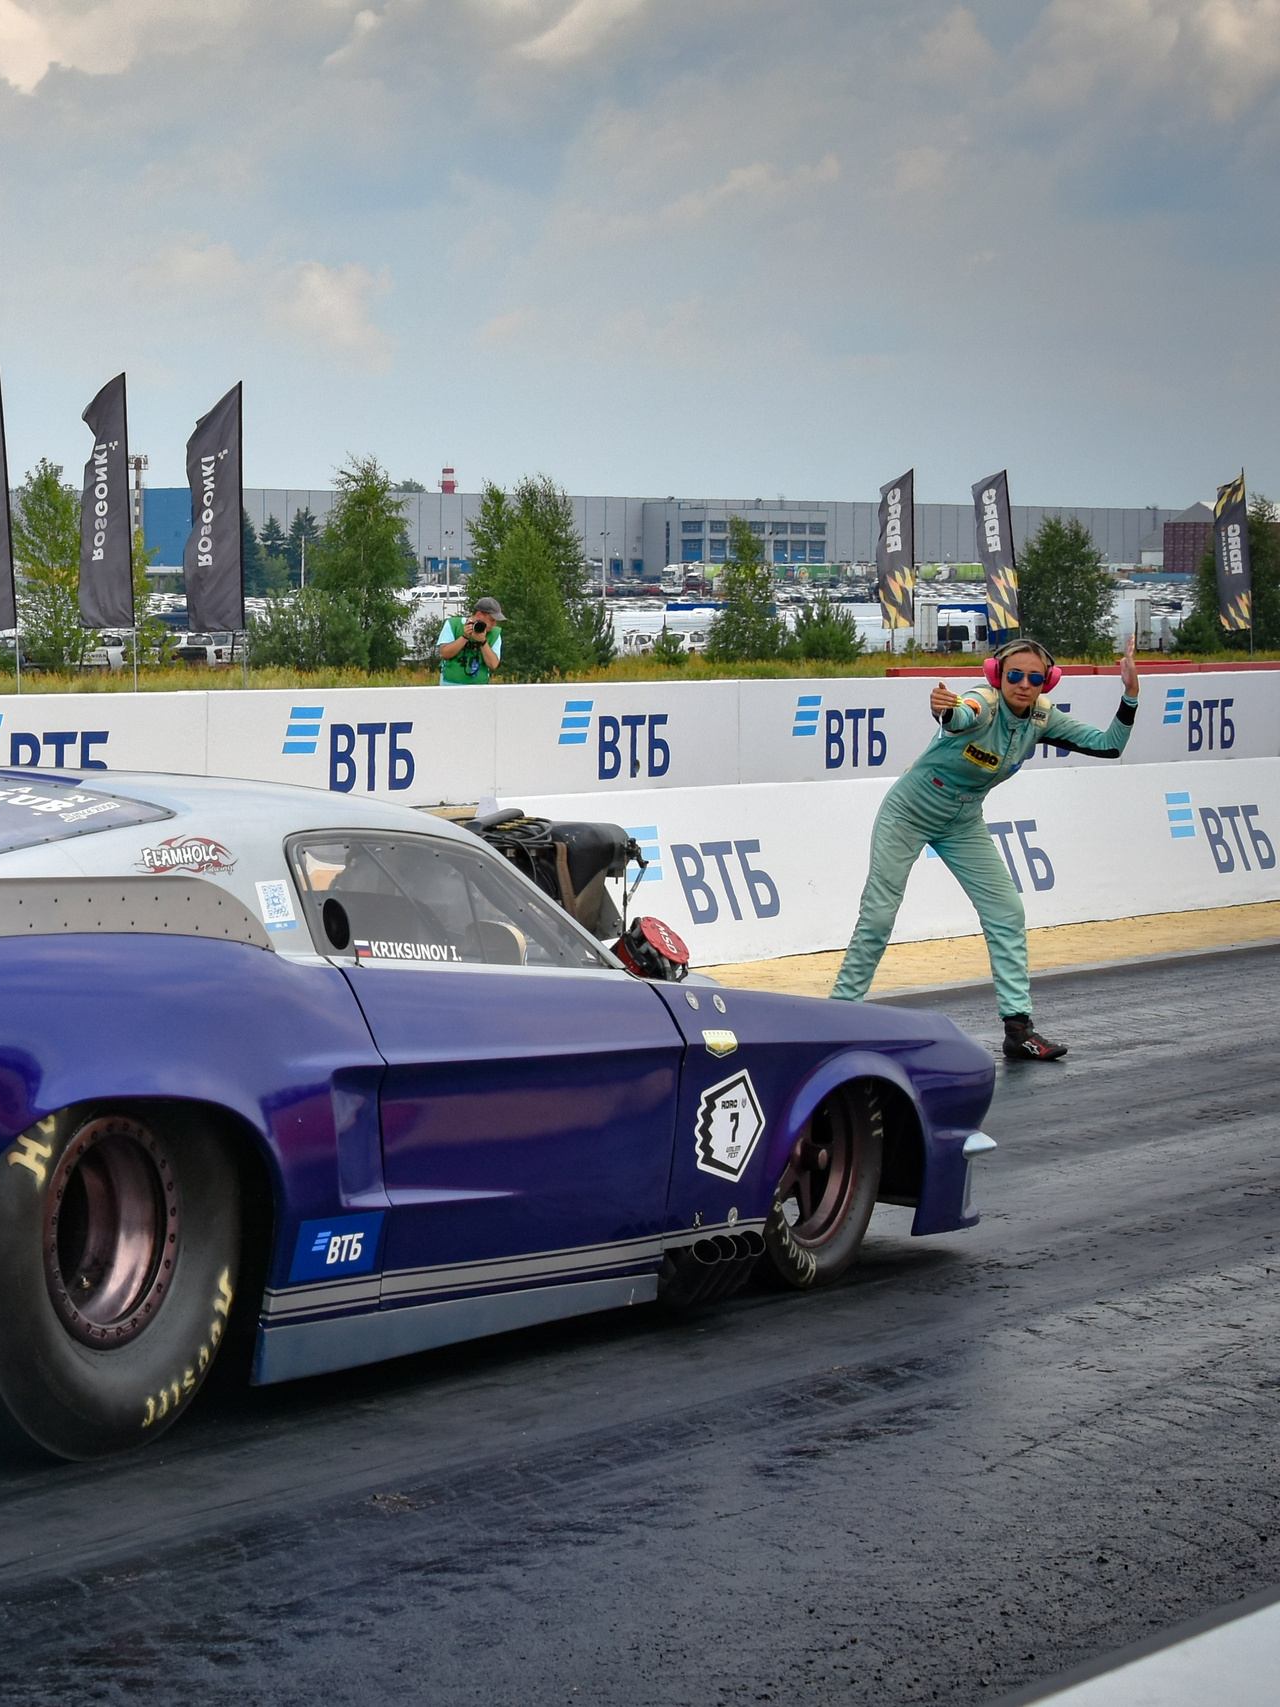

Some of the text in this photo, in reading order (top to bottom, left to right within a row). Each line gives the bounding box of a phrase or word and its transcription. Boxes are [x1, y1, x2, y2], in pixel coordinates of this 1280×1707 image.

[598, 713, 670, 780] ВТБ
[825, 706, 887, 769] ВТБ
[1188, 697, 1235, 752] ВТБ
[329, 721, 416, 792] ВТБ
[987, 819, 1056, 893] ТБ
[1199, 803, 1277, 874] ВТБ
[671, 838, 781, 924] ВТБ
[370, 940, 463, 962] KRIKSUNOV I.
[655, 922, 678, 954] MSD
[729, 1112, 740, 1143] 7
[326, 1232, 365, 1265] ВТБ
